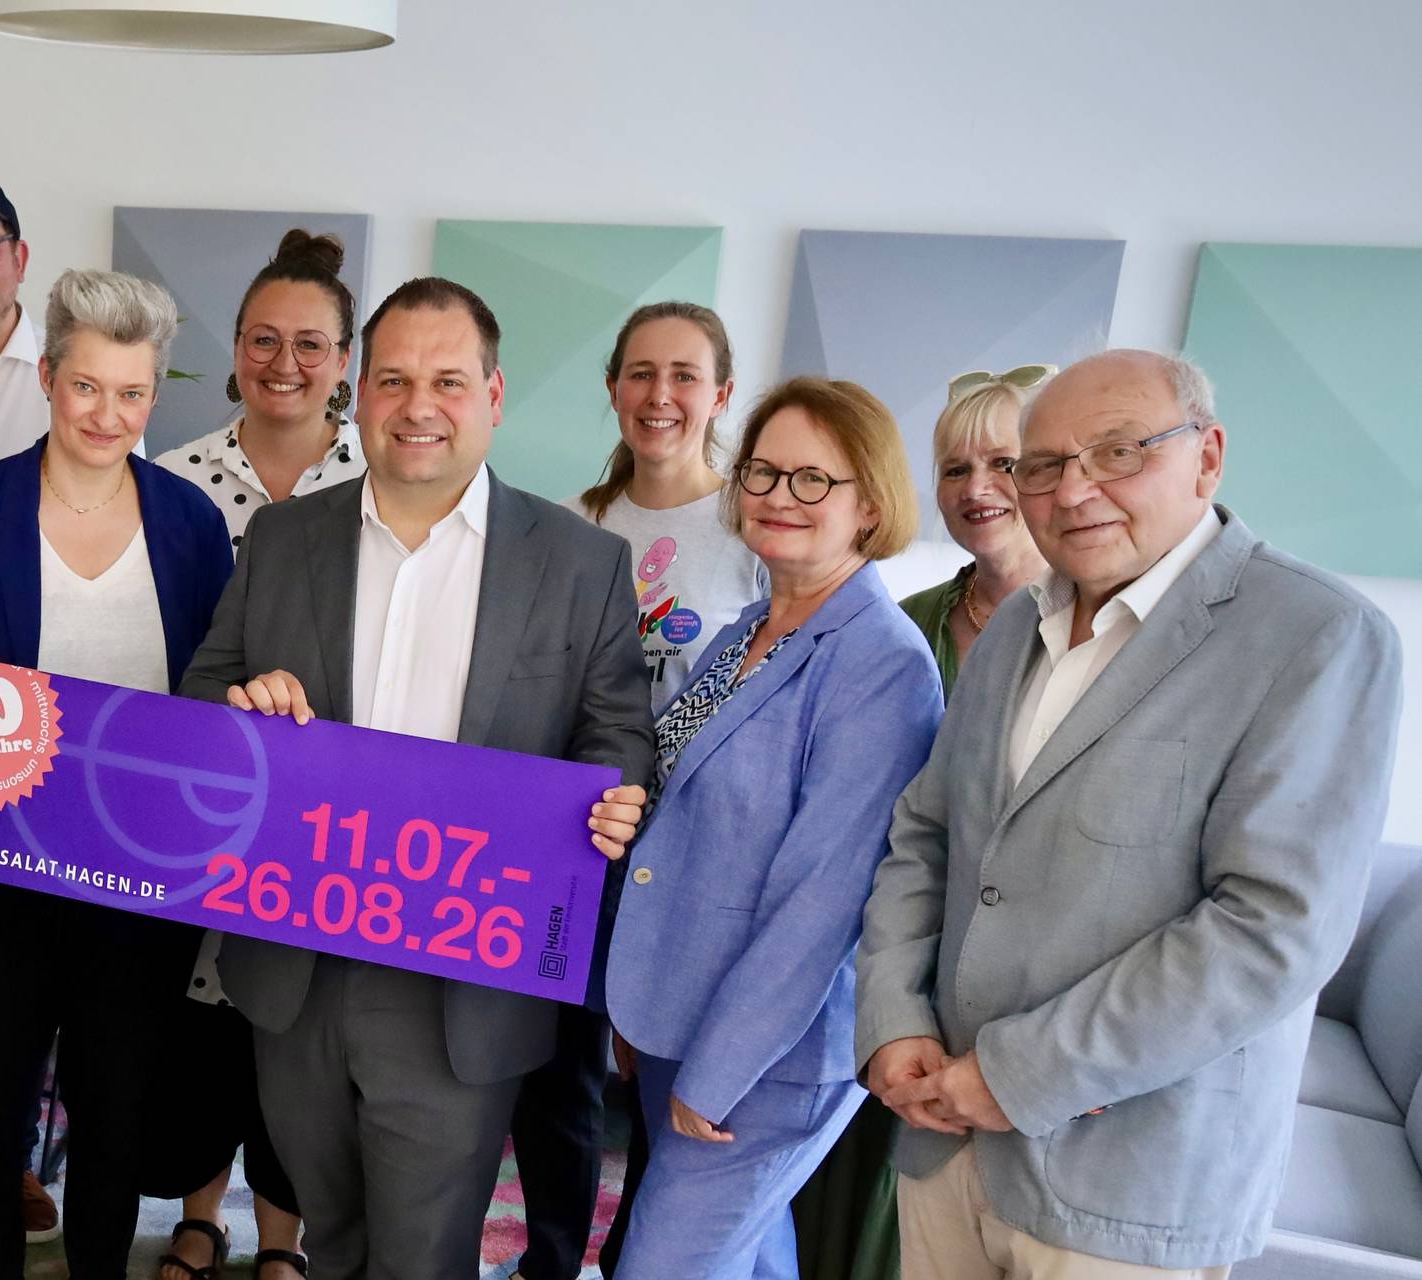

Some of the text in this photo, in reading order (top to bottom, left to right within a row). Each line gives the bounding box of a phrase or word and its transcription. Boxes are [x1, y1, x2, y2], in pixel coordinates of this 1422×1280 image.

[665, 646, 682, 657] air
[29, 681, 50, 755] mittwochs,
[302, 802, 531, 894] 11.07.-
[202, 853, 526, 969] 26.08.26
[545, 905, 564, 950] HAGEN
